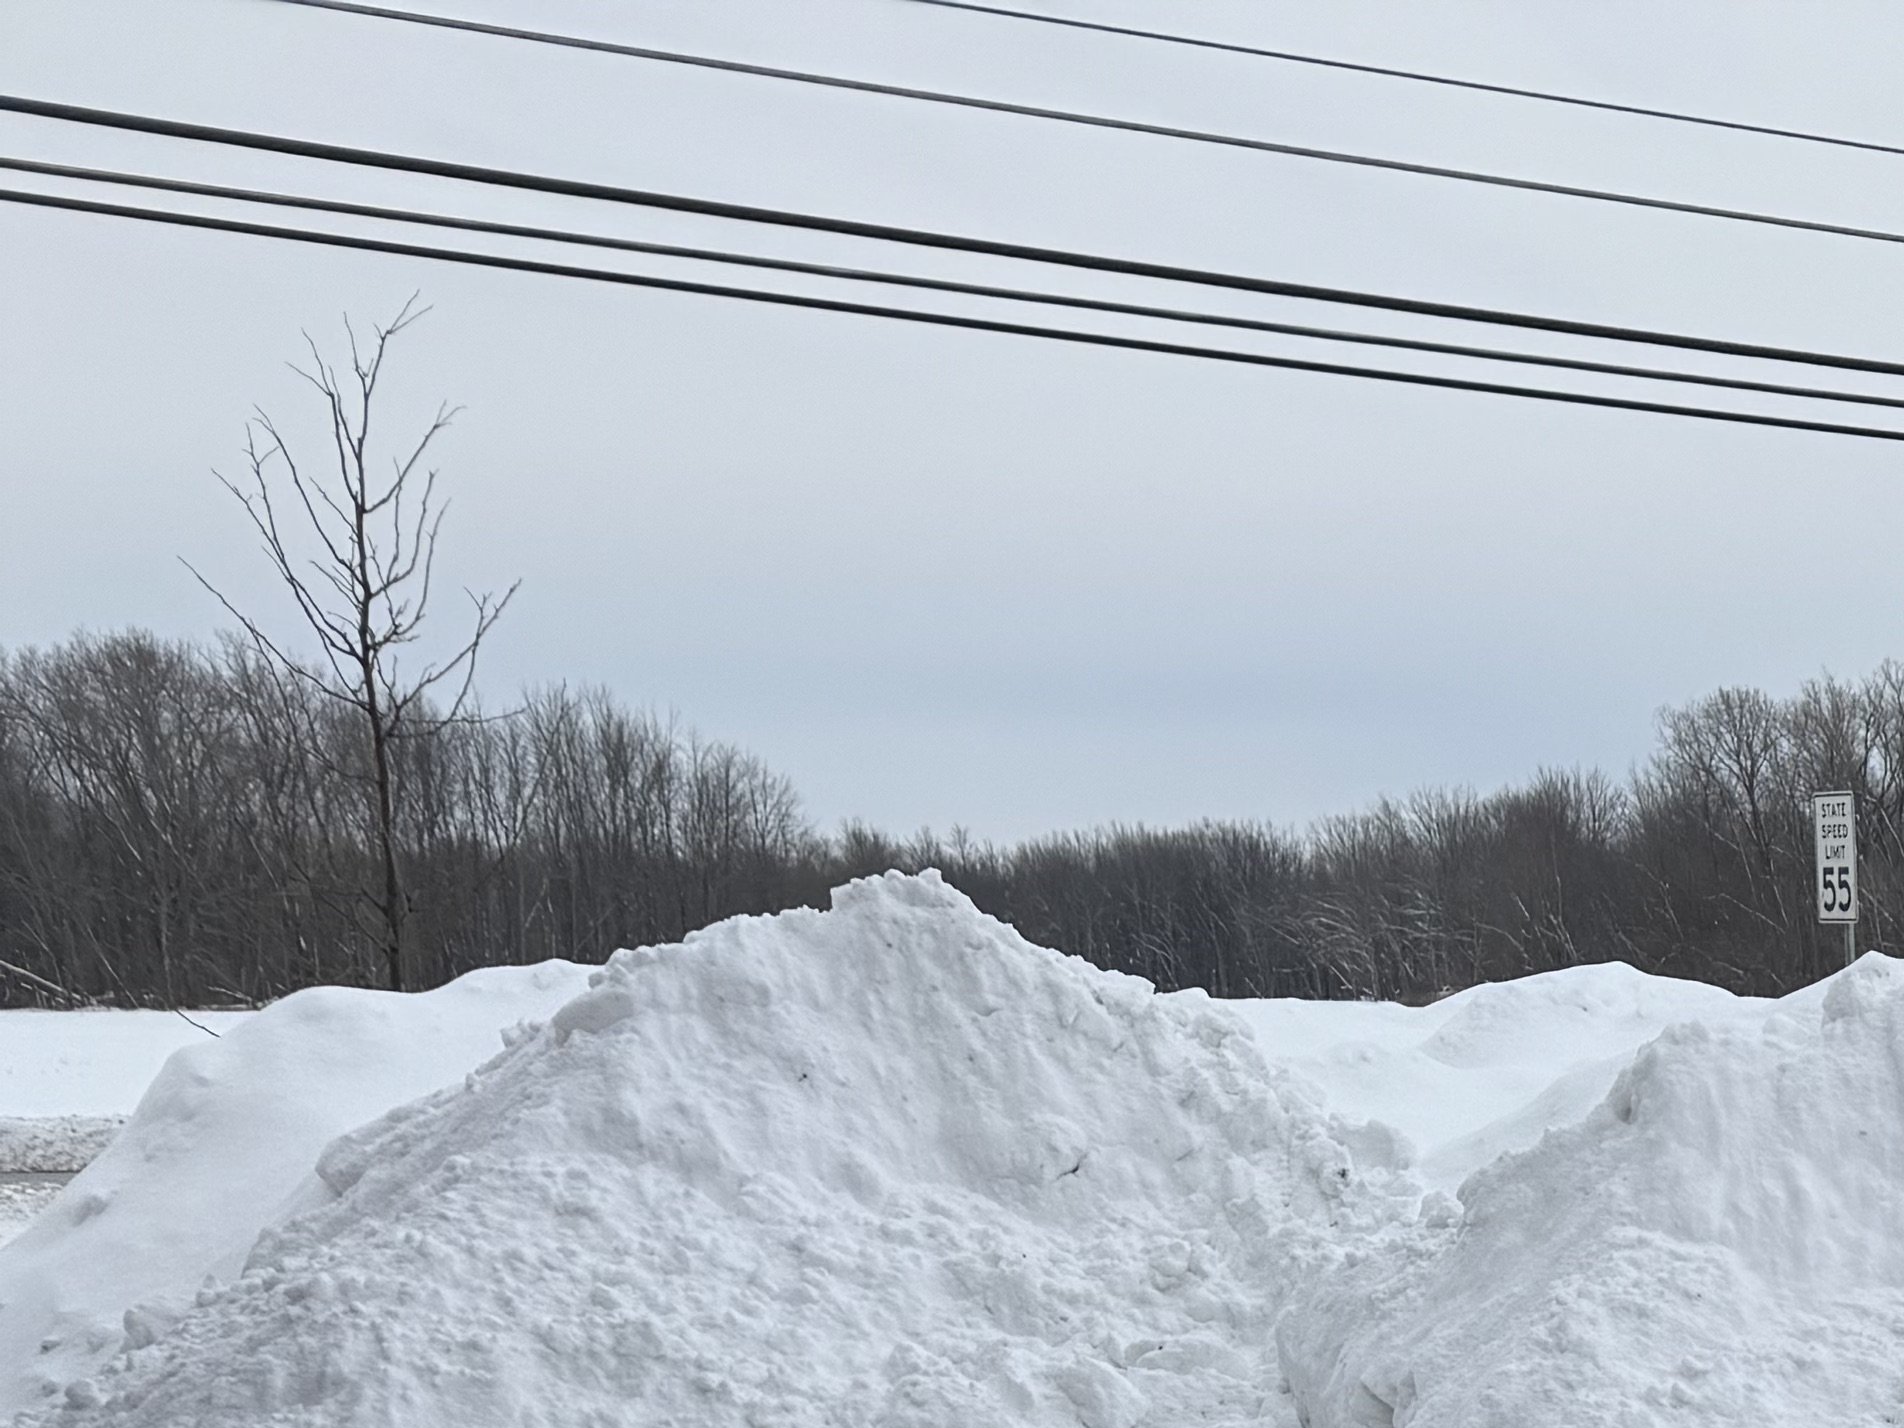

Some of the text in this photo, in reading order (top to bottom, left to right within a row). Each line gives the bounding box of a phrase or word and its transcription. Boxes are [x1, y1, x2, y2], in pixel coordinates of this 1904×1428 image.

[1822, 802, 1846, 818] STATE
[1822, 824, 1848, 839] SPEED
[1825, 845, 1845, 859] LIMIT
[1822, 866, 1852, 912] 55
